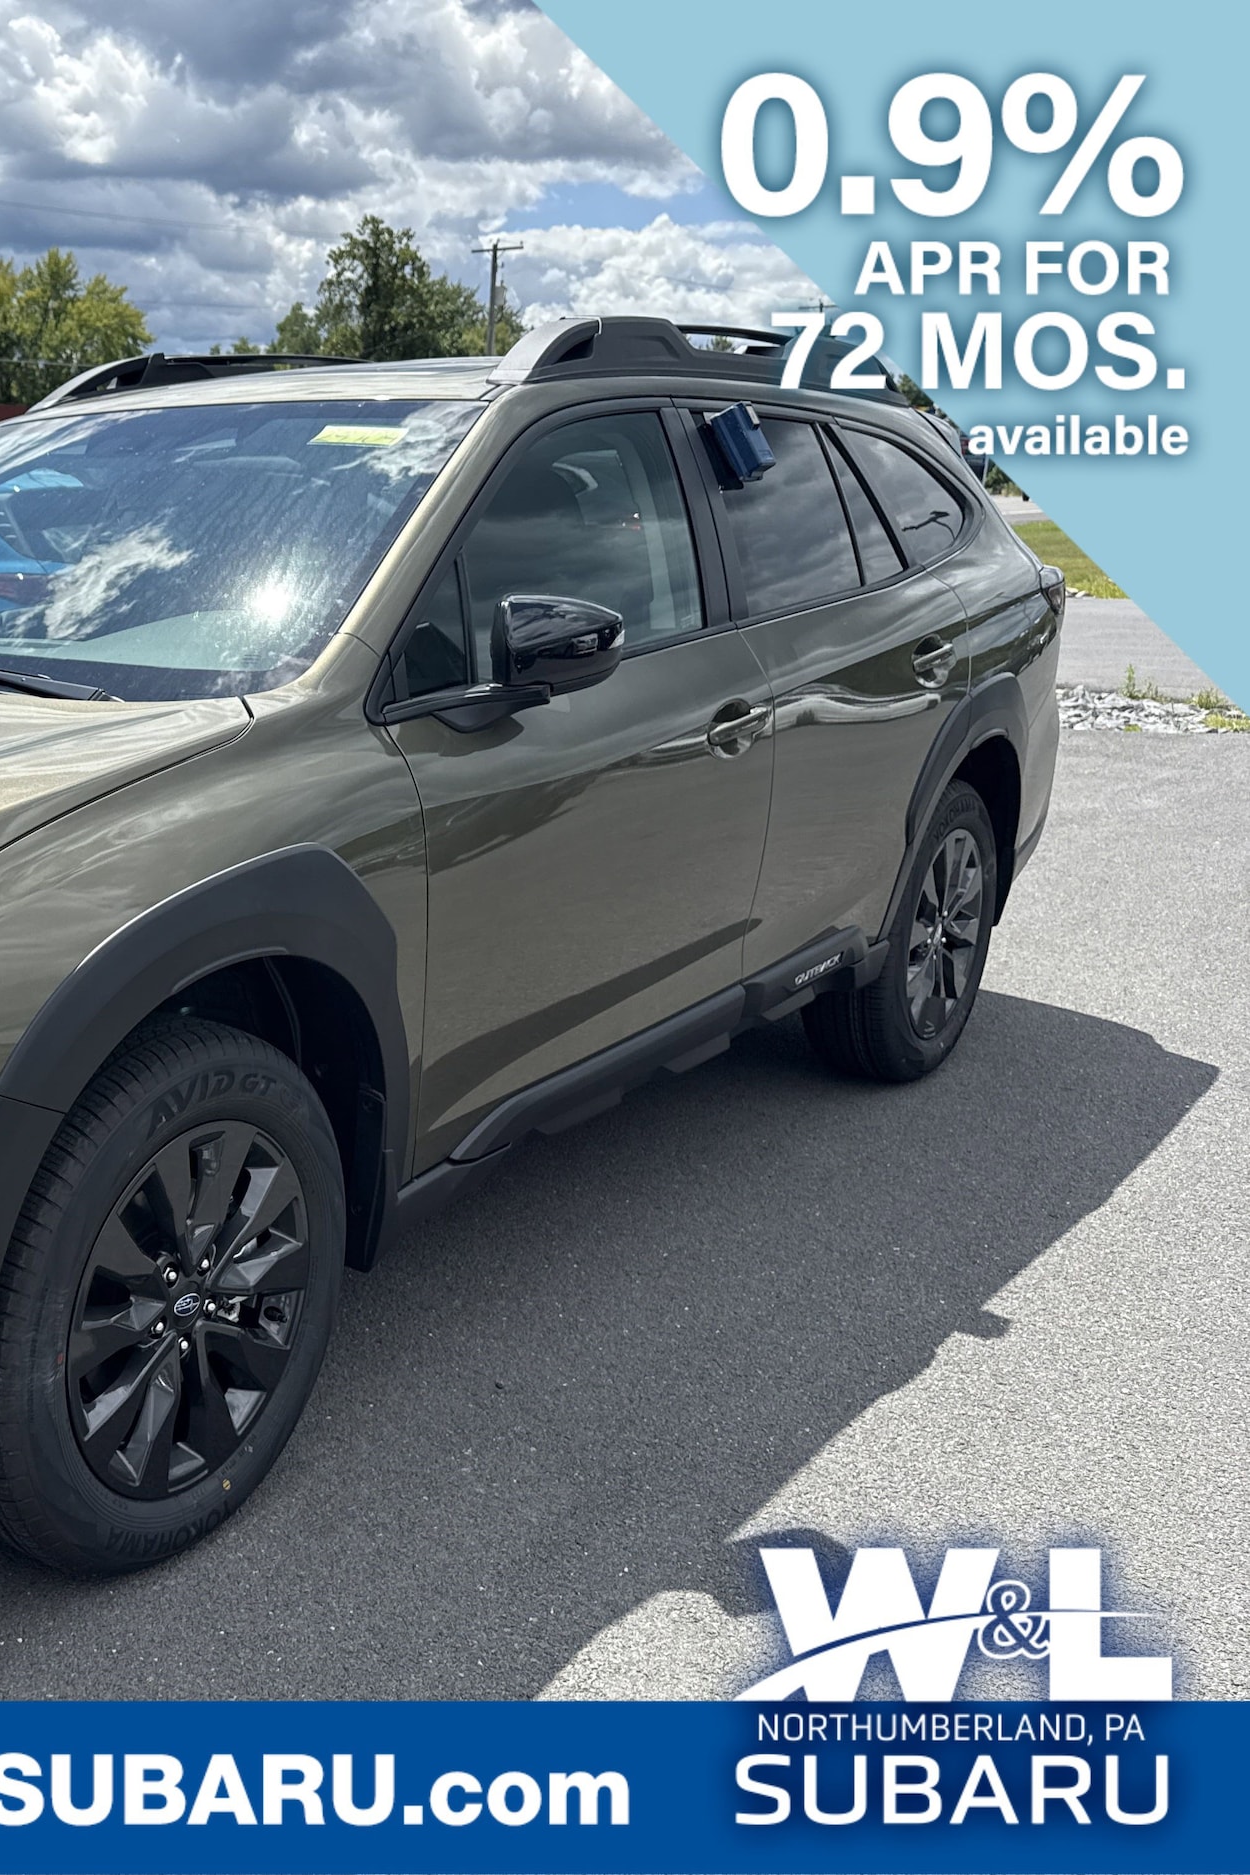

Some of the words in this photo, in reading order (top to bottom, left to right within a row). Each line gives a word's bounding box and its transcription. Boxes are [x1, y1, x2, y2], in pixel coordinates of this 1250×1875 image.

[794, 953, 841, 986] OUTBACK
[147, 1068, 236, 1142] AVID
[239, 1072, 277, 1097] GT
[105, 1499, 233, 1557] YOKOHAMA
